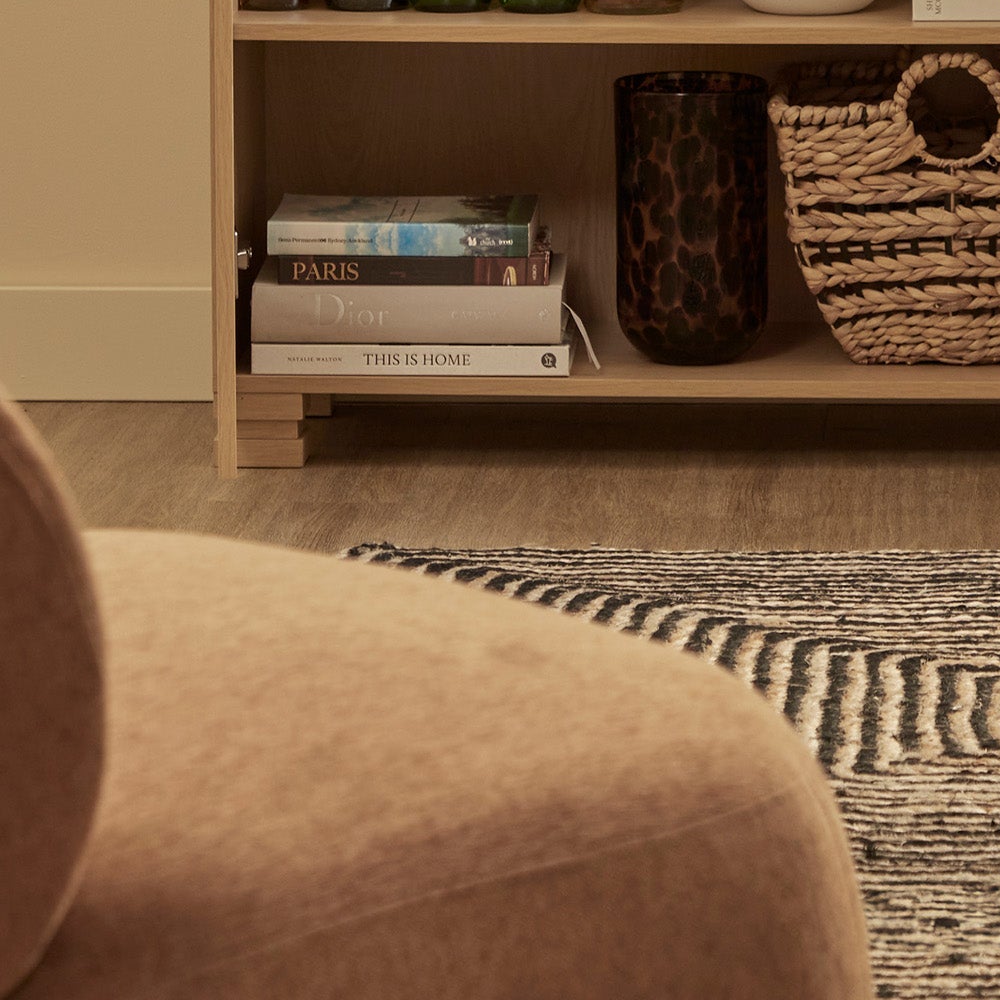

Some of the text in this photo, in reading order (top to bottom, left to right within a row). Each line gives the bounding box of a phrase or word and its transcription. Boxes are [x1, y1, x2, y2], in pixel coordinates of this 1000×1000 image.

[292, 262, 359, 282] PARIS
[316, 294, 389, 327] Dior
[363, 354, 401, 366] THIS
[405, 354, 418, 366] IS
[422, 354, 471, 366] HOME
